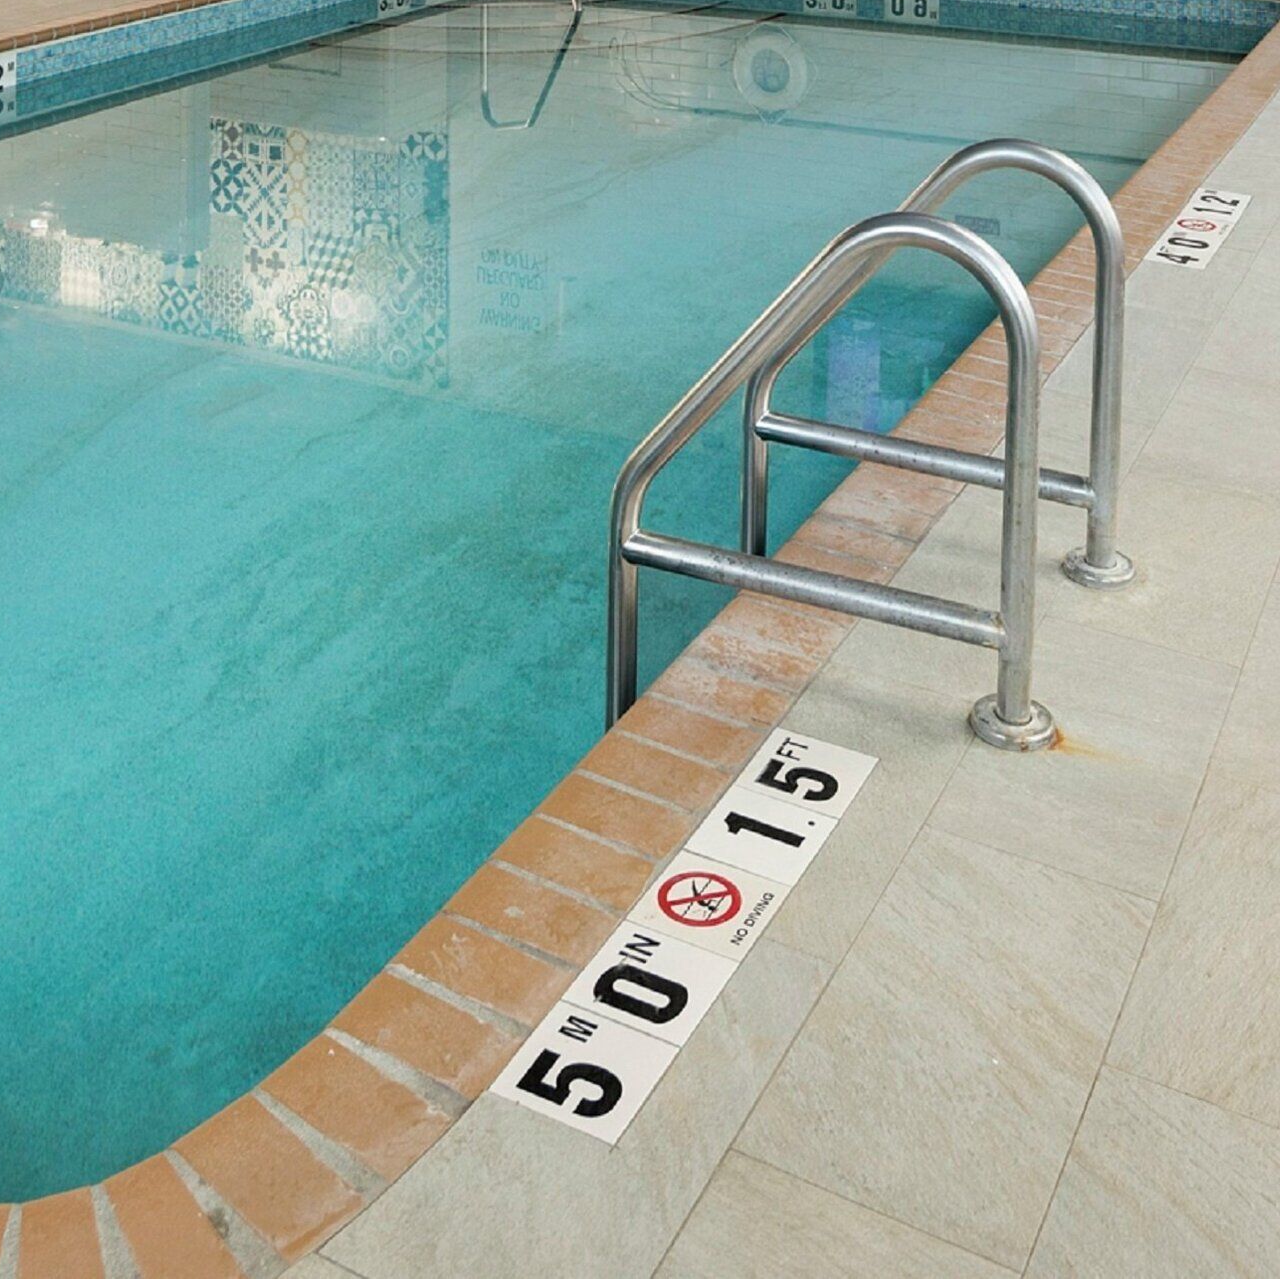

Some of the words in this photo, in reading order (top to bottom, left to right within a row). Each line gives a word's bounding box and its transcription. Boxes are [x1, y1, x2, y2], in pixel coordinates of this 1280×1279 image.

[1156, 252, 1200, 264] 4
[776, 737, 808, 761] FT
[730, 927, 749, 946] NO
[743, 892, 775, 927] DIVING
[619, 933, 662, 964] IN
[593, 963, 689, 1025] 0
[558, 1014, 599, 1043] M
[516, 1048, 624, 1119] 5
